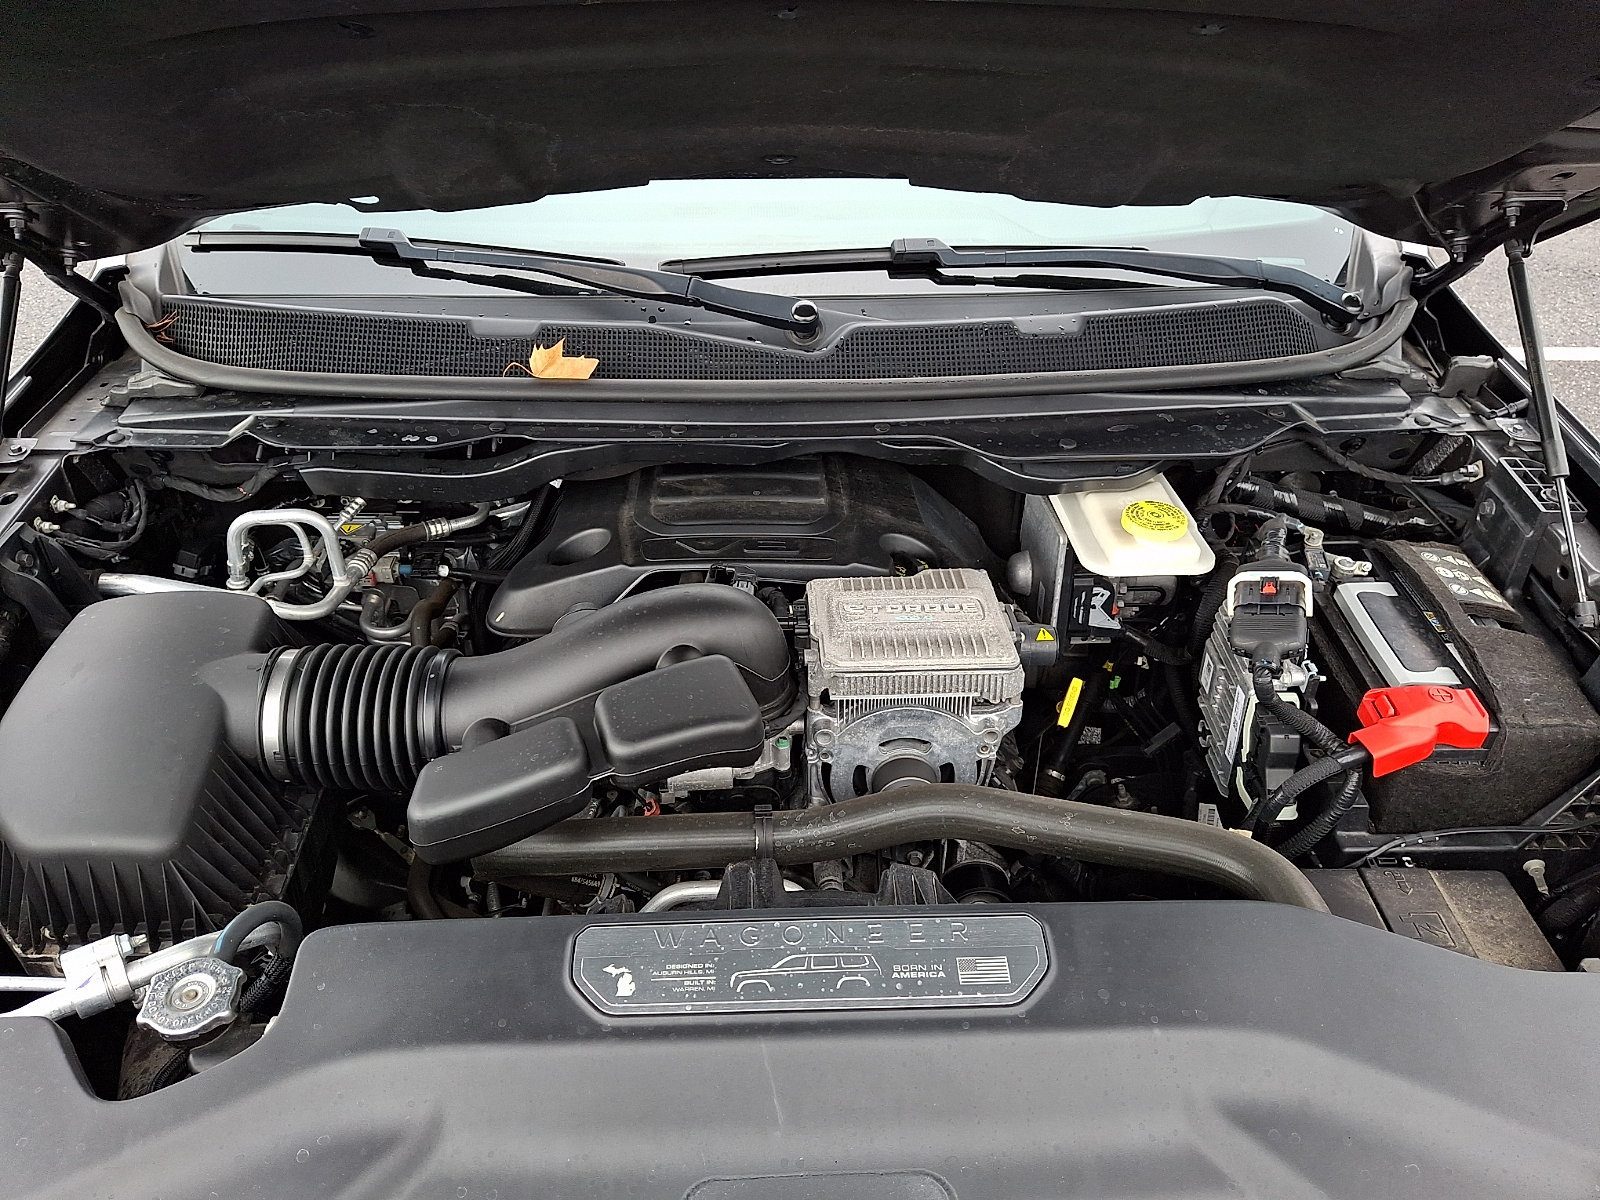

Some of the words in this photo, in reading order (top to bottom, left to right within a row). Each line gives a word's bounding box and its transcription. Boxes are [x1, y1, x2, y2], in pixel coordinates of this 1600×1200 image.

[653, 923, 968, 949] WAGONEER
[931, 963, 944, 971] IN
[891, 970, 946, 979] AMERICA
